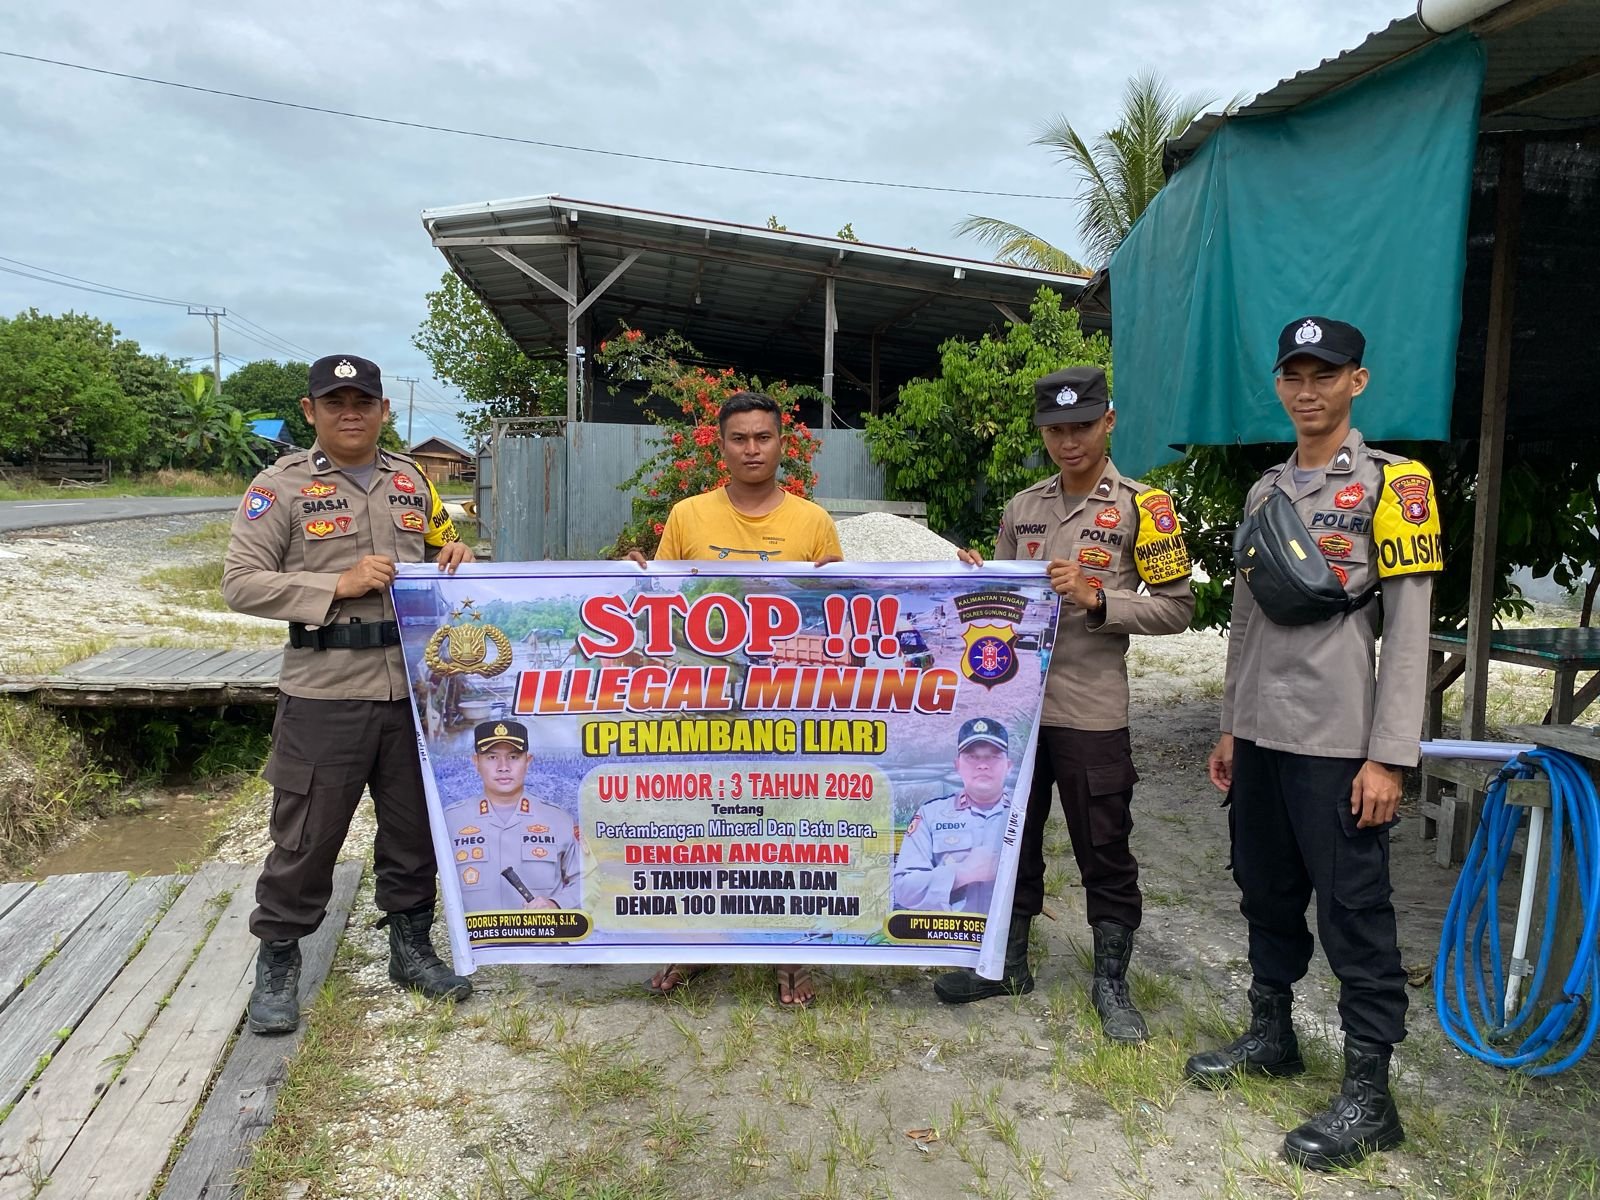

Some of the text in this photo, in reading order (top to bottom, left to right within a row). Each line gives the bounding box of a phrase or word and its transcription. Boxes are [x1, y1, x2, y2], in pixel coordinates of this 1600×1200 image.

[388, 495, 424, 507] POLRI
[1015, 524, 1047, 535] YONGKI
[1311, 511, 1370, 533] POLRI
[1080, 528, 1123, 546] POLRI
[1146, 552, 1173, 566] FOOD
[1380, 533, 1435, 569] OLISI
[1149, 567, 1182, 583] POLSEK
[958, 595, 1025, 607] KALIMANTAN TENGAH
[962, 609, 984, 619] POLRES
[984, 609, 1007, 617] GUNUNG
[577, 591, 901, 660] STOP !!!
[511, 665, 960, 716] ILLEGAL MINING
[582, 718, 887, 757] (PENAMBANG LIAR)
[598, 775, 630, 801] UU
[635, 772, 713, 800] NOMOR
[730, 772, 743, 799] 3
[749, 772, 820, 799] TAHUN
[825, 772, 875, 800] 2020
[711, 803, 764, 817] Tentang
[595, 819, 878, 843] Pertambangan Mineral Dan Batu Bara.
[453, 835, 556, 847] THEO POLRI
[625, 843, 850, 866] DENGAN ANCAMAN
[633, 870, 838, 891] 5 TAHUN PENJARA DAN
[615, 895, 860, 917] DENDA 100 MILYAR RUPIAH
[465, 914, 578, 929] ODORUS PRIYO SANTOSA, S.I.K.
[910, 917, 931, 929] IPTU
[932, 918, 962, 931] DEBBY
[501, 927, 537, 937] GUNUNG
[538, 927, 555, 936] MAS
[927, 931, 969, 941] KAPOLSEK
